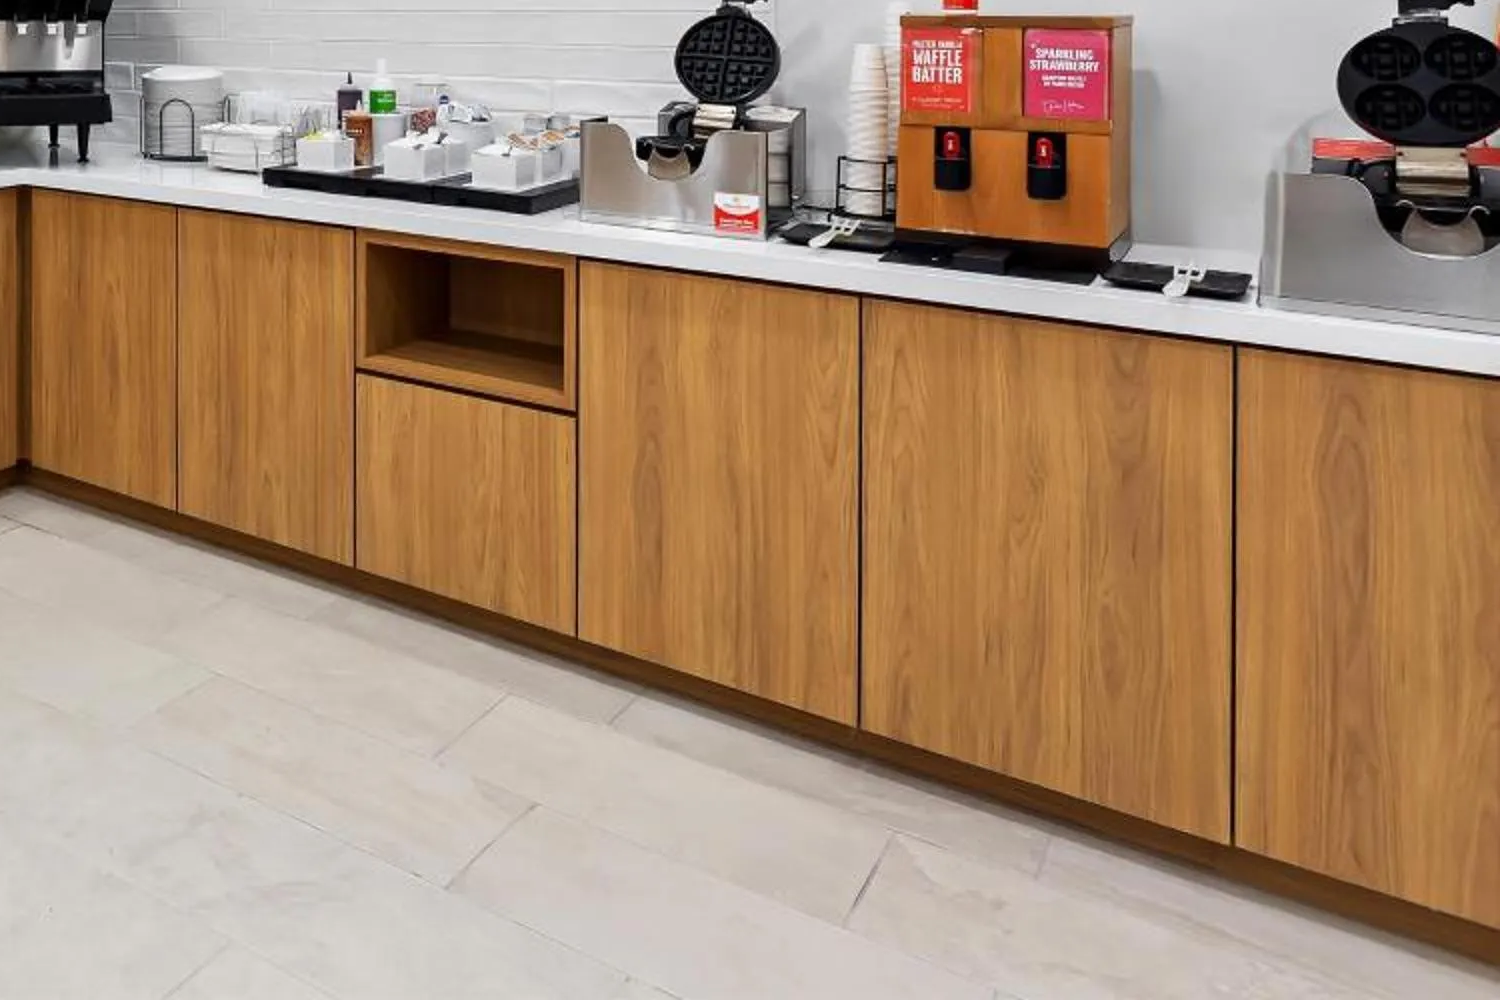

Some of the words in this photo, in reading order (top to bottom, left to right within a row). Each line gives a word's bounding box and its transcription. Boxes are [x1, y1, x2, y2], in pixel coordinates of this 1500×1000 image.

[912, 49, 963, 67] WAFFLE
[1035, 47, 1094, 60] SPARKLING
[912, 66, 963, 84] BATTER
